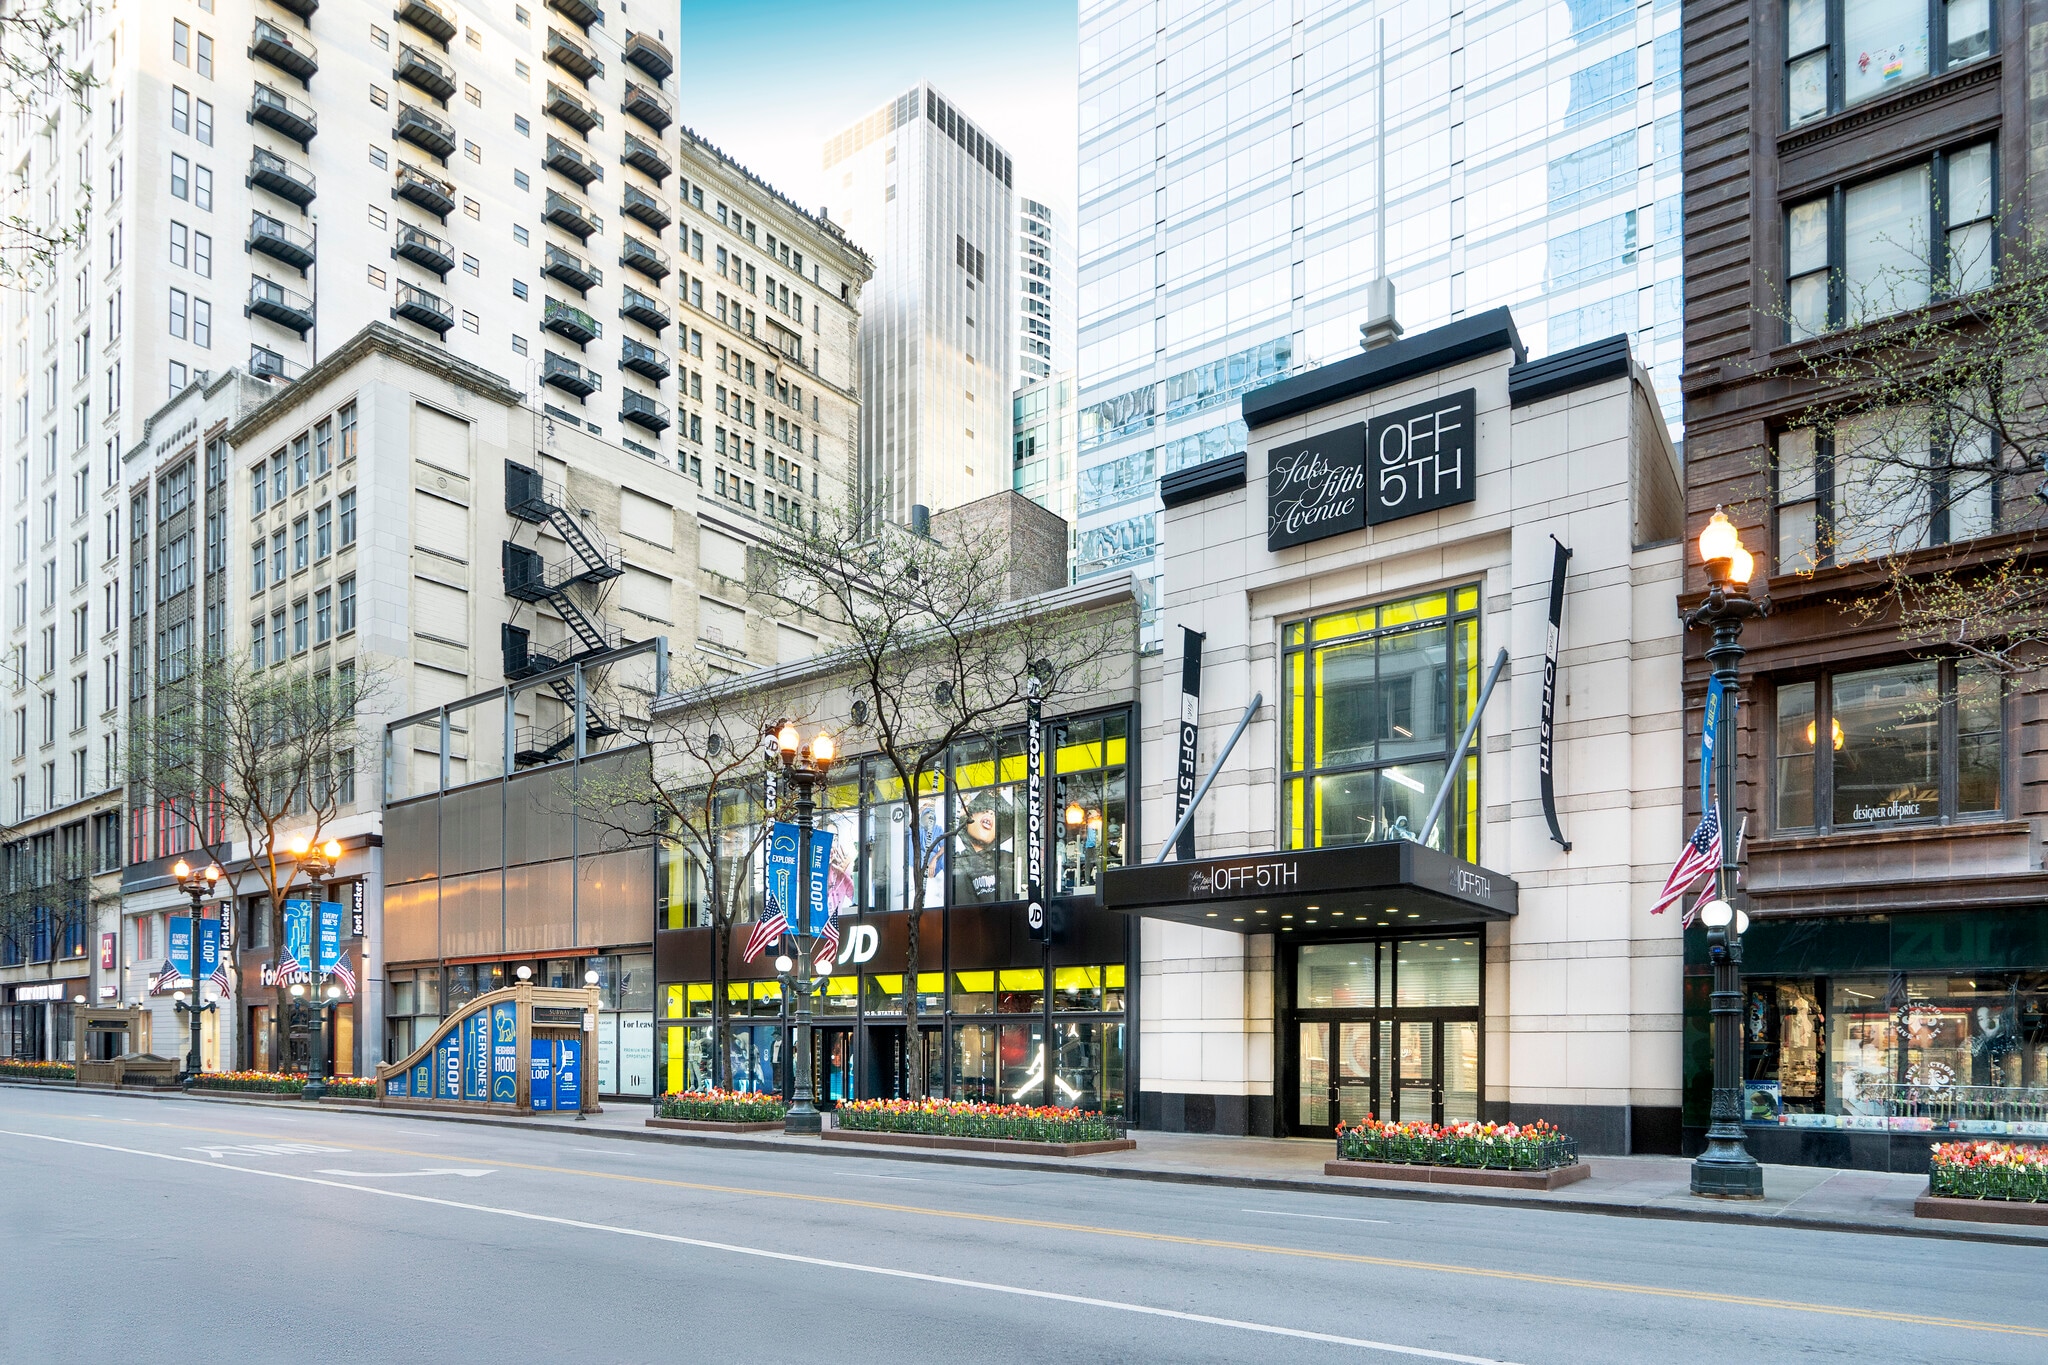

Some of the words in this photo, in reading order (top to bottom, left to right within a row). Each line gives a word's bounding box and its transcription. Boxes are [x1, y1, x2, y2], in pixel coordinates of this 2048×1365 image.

[1380, 405, 1461, 465] OFF
[1268, 450, 1330, 497] Saks
[1381, 448, 1461, 507] 5TH
[1268, 497, 1355, 538] Avenue
[1543, 662, 1553, 721] OFF
[766, 738, 779, 752] JD
[1182, 727, 1195, 774] OFF
[1540, 721, 1550, 774] 5TH
[1029, 719, 1040, 887] JDSPORTS.COM
[772, 854, 796, 865] EXPLORE
[814, 855, 823, 868] THE
[816, 845, 823, 854] IN
[1214, 865, 1254, 890] OFF
[1256, 862, 1297, 887] 5TH
[1460, 869, 1475, 893] OFF
[1475, 875, 1491, 899] 5TH
[353, 881, 363, 913] Locker
[811, 871, 823, 912] LOOP
[221, 903, 230, 930] Locker
[353, 914, 363, 934] Foot
[1030, 909, 1042, 922] JD
[103, 939, 112, 962] T
[203, 940, 215, 963] LOOP
[221, 931, 230, 949] Foot
[838, 925, 878, 965] JD
[623, 1020, 634, 1028] For
[447, 1046, 459, 1095] LOOP
[478, 1018, 487, 1097] EVERYONE'S
[495, 1056, 515, 1072] HOOD
[531, 1069, 549, 1079] LOOP
